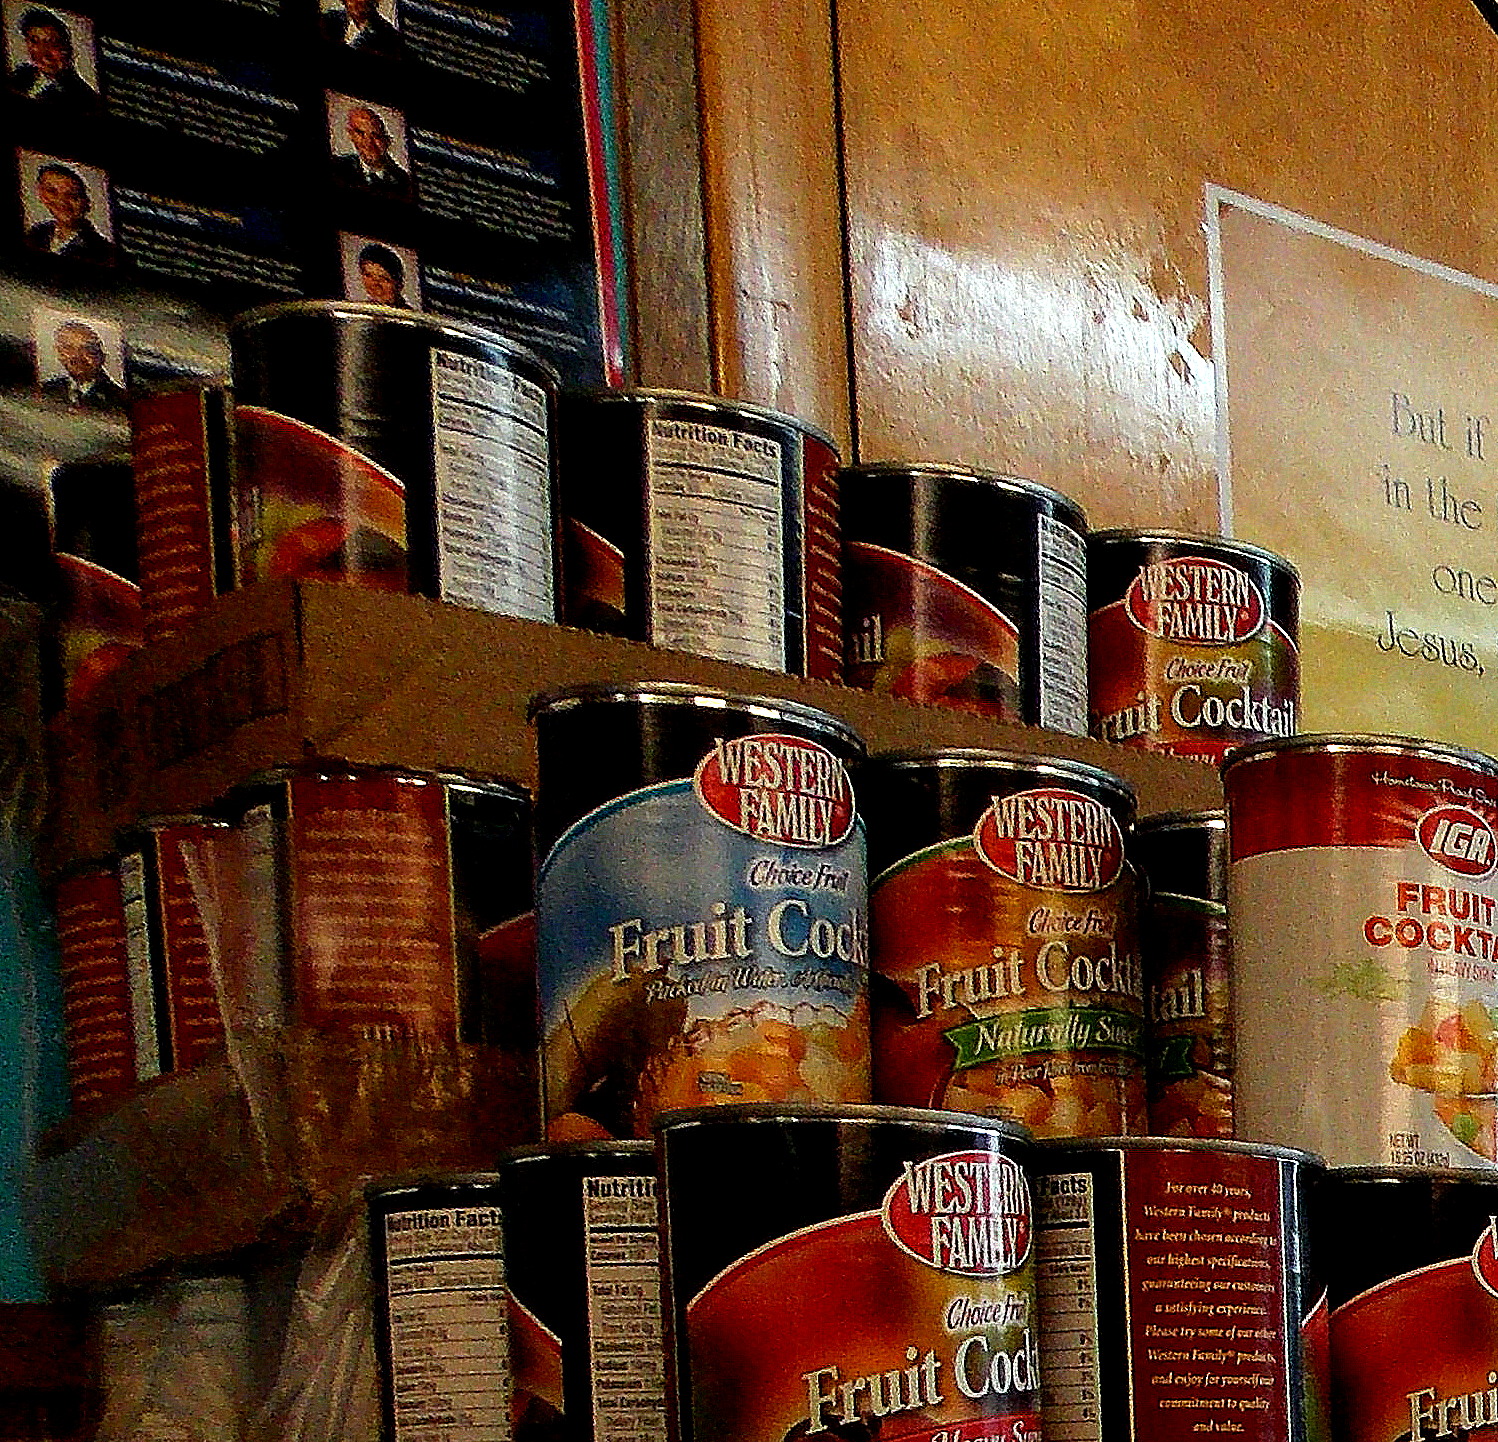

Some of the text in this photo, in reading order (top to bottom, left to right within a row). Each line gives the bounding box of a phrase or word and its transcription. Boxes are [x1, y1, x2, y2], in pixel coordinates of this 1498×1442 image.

[653, 421, 777, 459] Nutrition Facts
[1392, 393, 1449, 451] But
[1466, 417, 1488, 460] if
[1383, 465, 1410, 510] in
[1428, 477, 1482, 529] the
[1139, 564, 1251, 606] WESTERN
[1433, 564, 1497, 605] one
[1157, 601, 1238, 642] FAMILY
[1378, 610, 1484, 676] Jesus,
[1166, 657, 1214, 681] Choice
[1170, 683, 1297, 736] Cocktail
[715, 739, 846, 804] WESTERN
[740, 793, 840, 844] FAMILY
[992, 795, 1113, 844] WESTERN
[1432, 820, 1492, 862] IGA
[748, 860, 812, 889] Choice
[1016, 840, 1103, 891] FAMILY
[1398, 883, 1495, 927] FRUIT
[610, 904, 753, 982] Fruit
[916, 947, 1025, 1019] Fruit
[974, 1020, 1090, 1056] Naturally
[903, 1158, 1028, 1214] WESTERN
[1145, 1205, 1185, 1217] Western
[930, 1214, 1020, 1271] FAMILY
[1135, 1229, 1160, 1242] have
[1162, 1229, 1187, 1242] been
[1189, 1231, 1222, 1242] chosen
[1168, 1253, 1204, 1269] highest
[945, 1296, 1002, 1329] Choice
[1165, 1302, 1214, 1316] satisfying
[1180, 1326, 1196, 1340] try
[1198, 1328, 1223, 1338] some
[1226, 1325, 1236, 1340] of
[1148, 1349, 1189, 1361] Western
[802, 1349, 942, 1434] Fruit
[1175, 1374, 1203, 1387] enjoy
[1205, 1372, 1219, 1387] for
[1227, 1399, 1237, 1408] to
